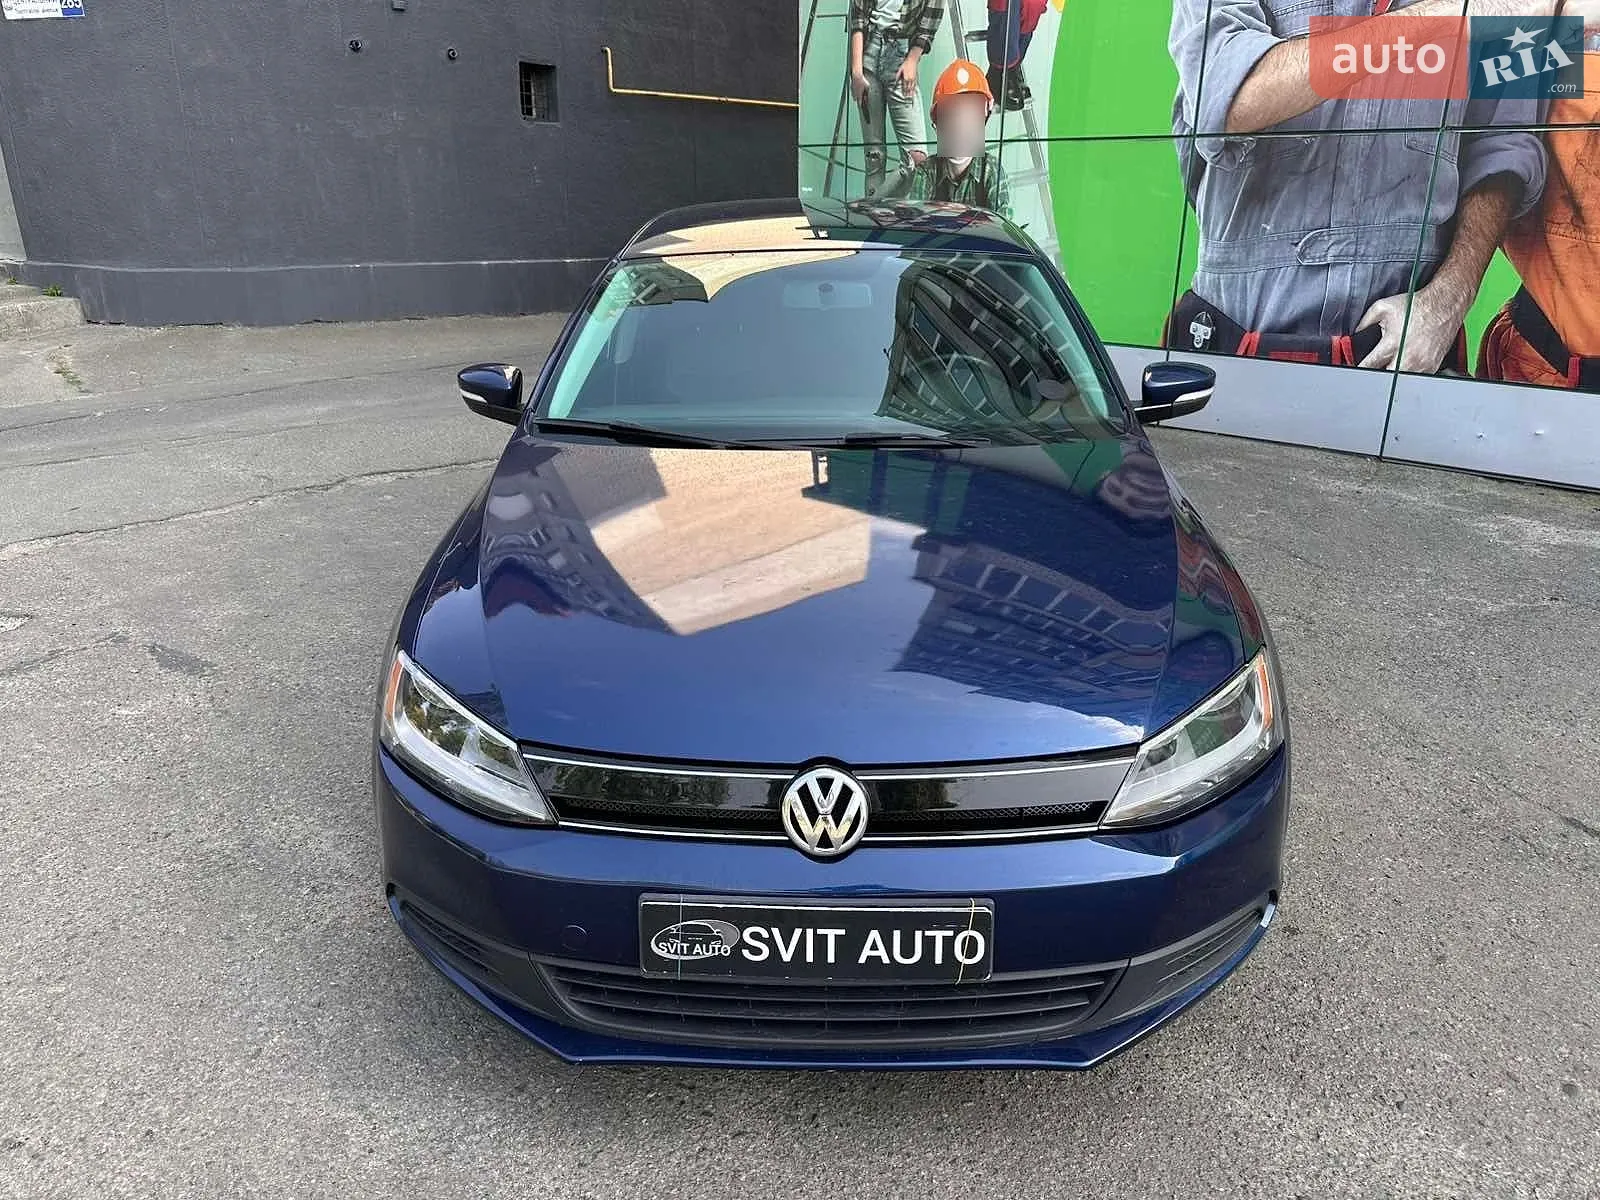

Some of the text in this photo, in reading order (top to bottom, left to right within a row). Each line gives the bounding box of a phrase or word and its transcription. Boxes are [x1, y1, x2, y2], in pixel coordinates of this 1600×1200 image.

[658, 942, 731, 957] SVIT AUTO
[741, 926, 986, 965] SVIT AUTO
